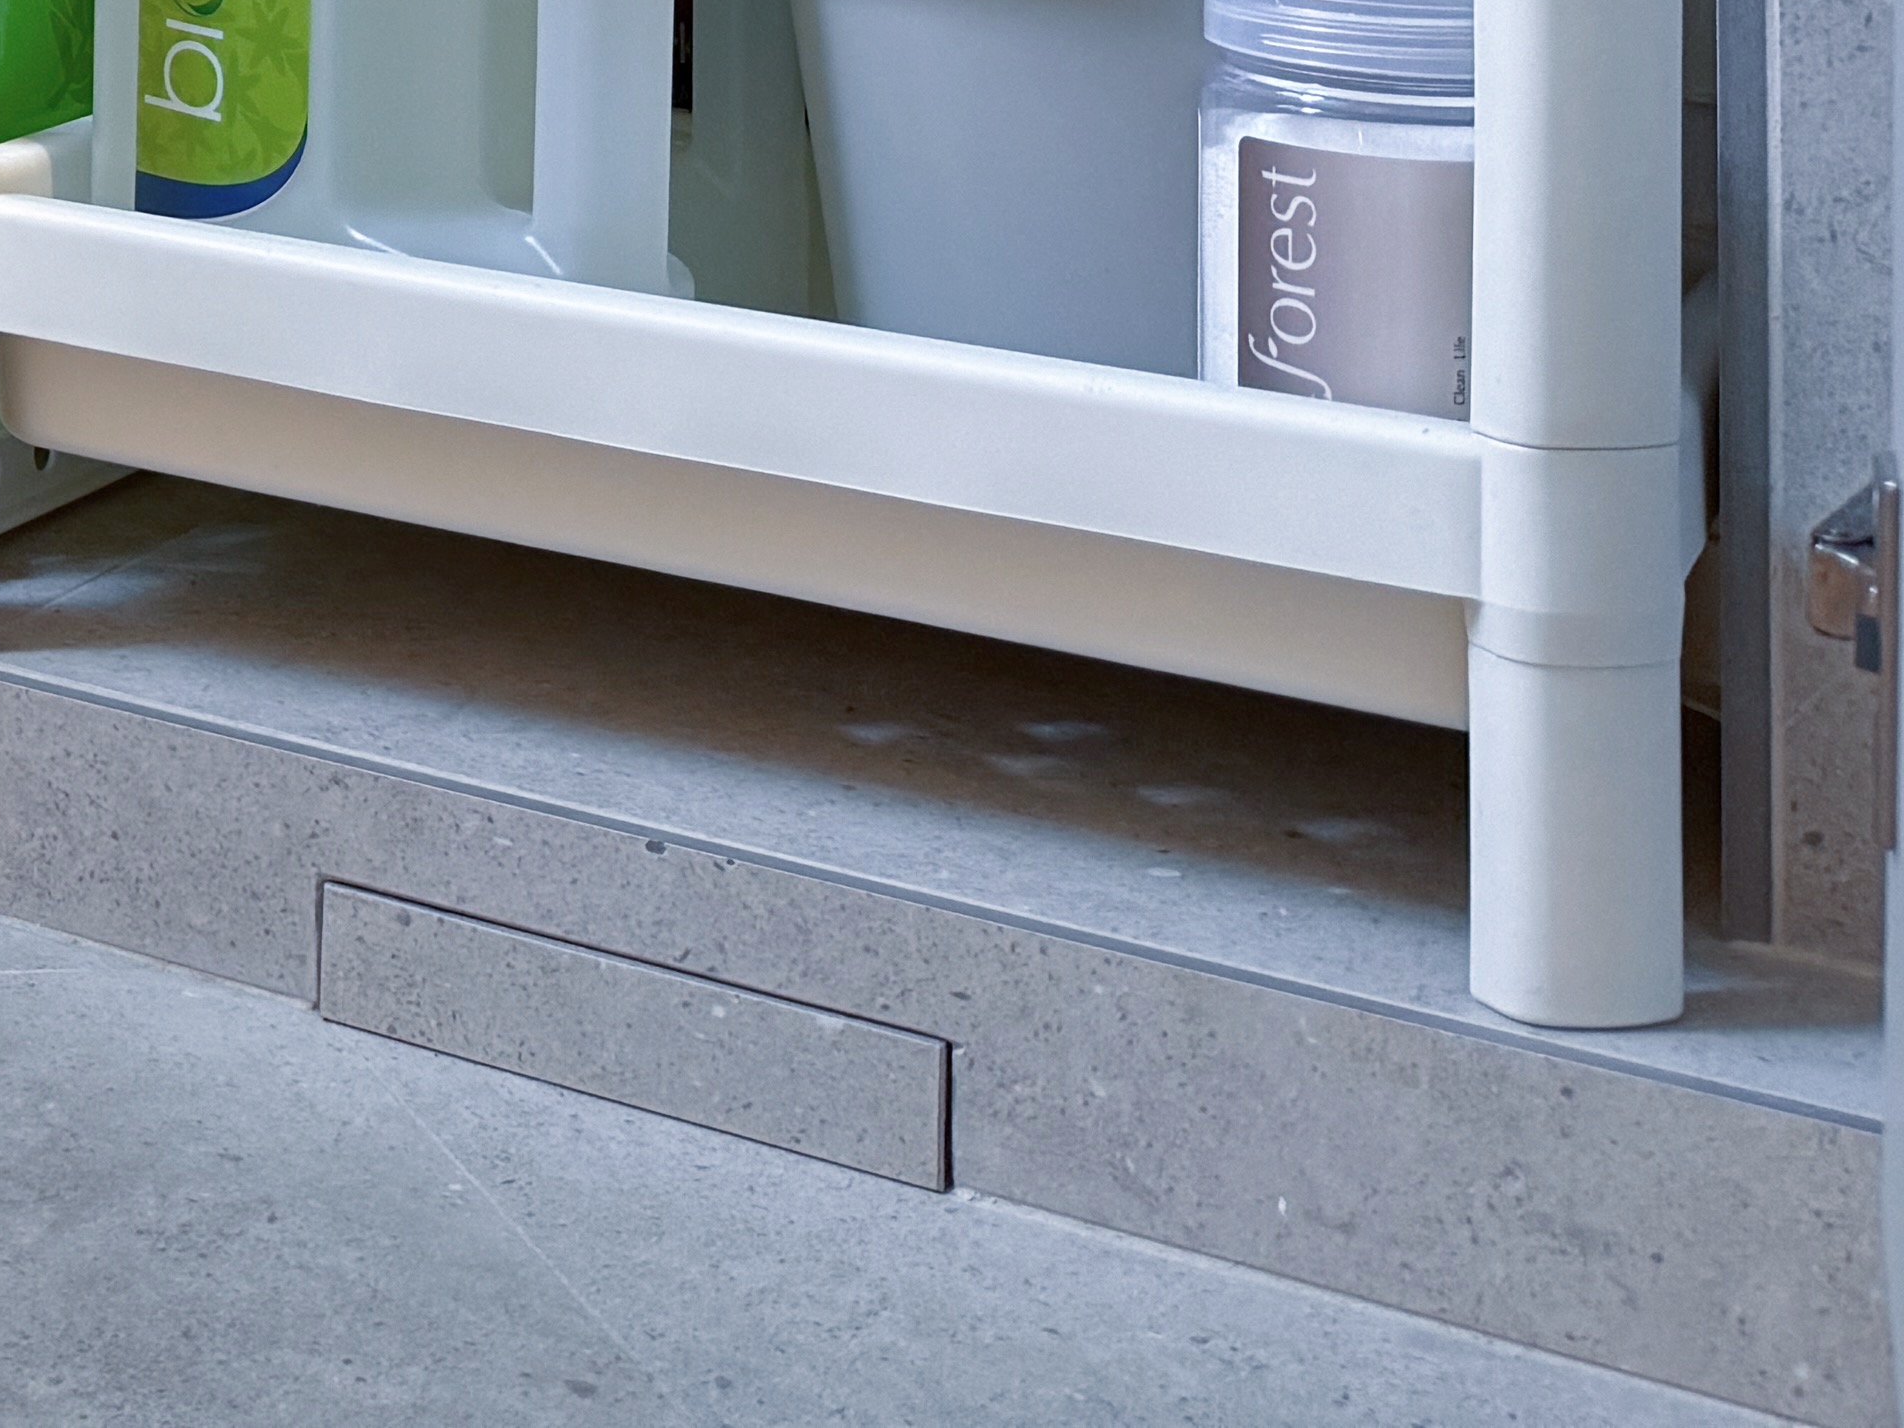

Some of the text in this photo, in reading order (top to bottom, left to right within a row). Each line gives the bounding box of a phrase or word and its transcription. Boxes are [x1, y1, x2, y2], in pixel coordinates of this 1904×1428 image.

[1248, 165, 1332, 401] forest
[1454, 336, 1467, 405] Clean Life
